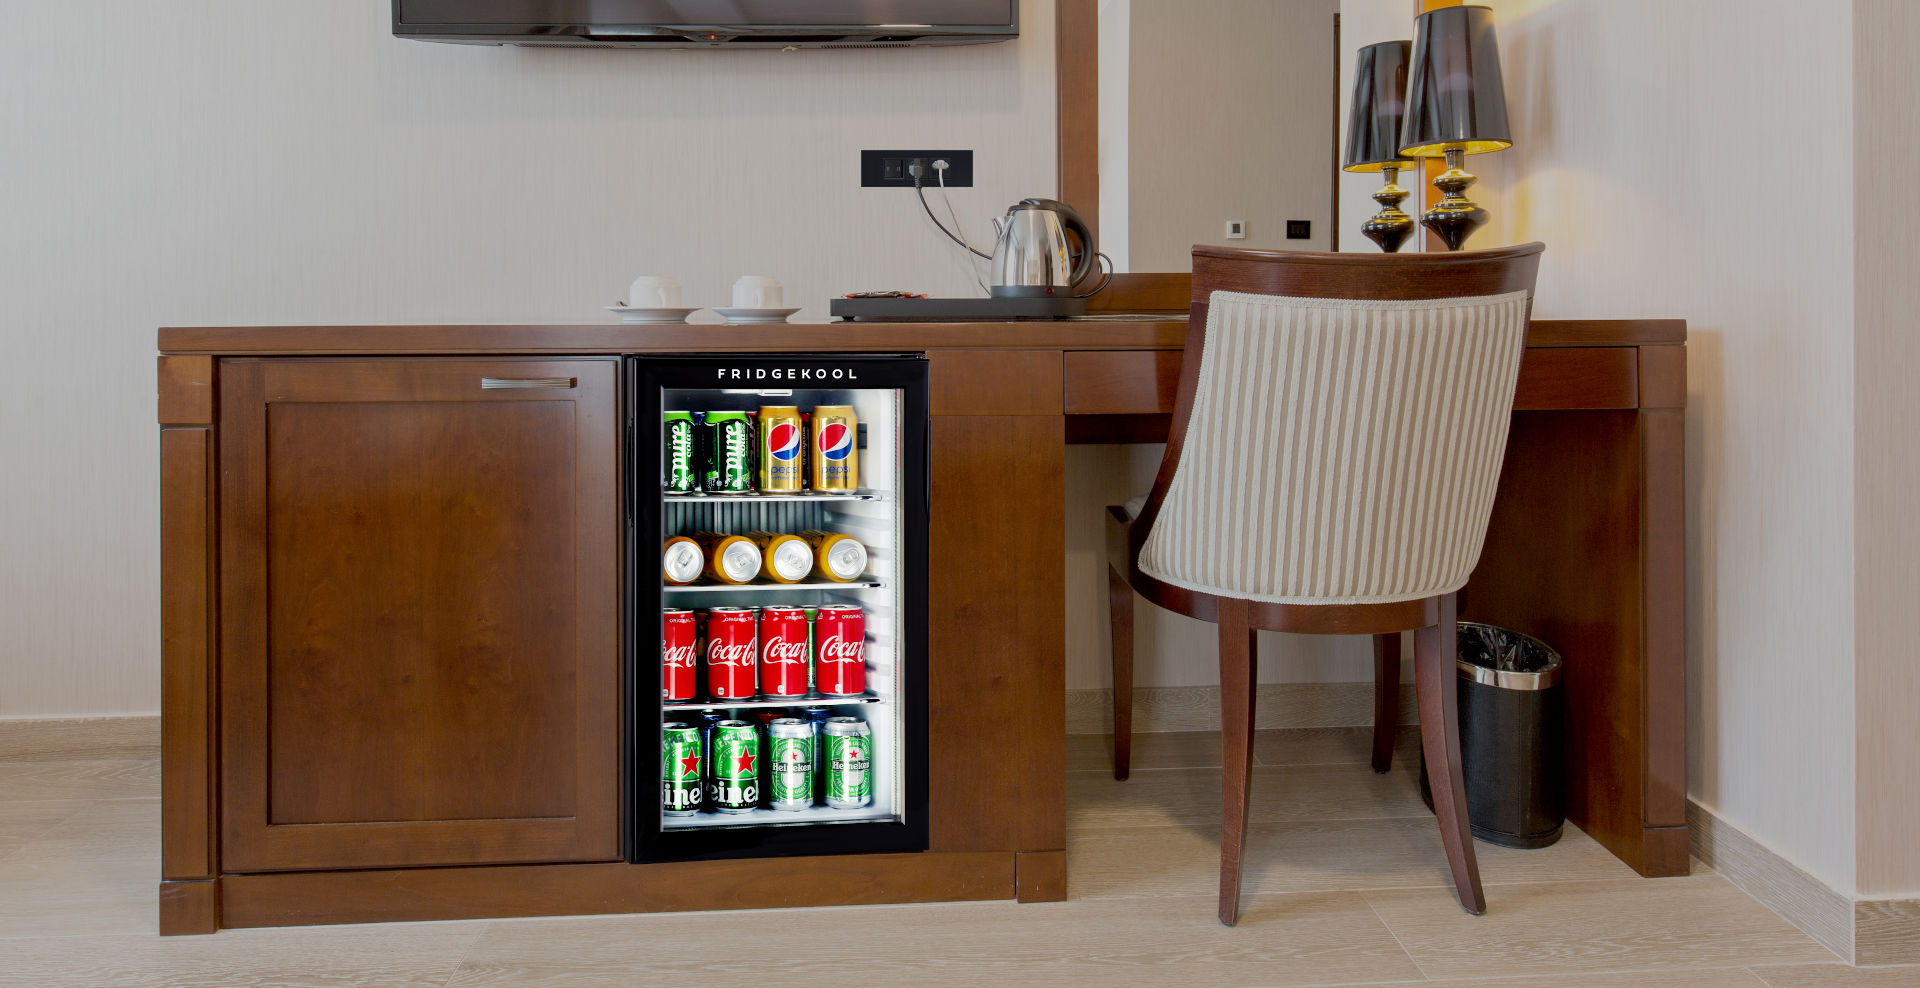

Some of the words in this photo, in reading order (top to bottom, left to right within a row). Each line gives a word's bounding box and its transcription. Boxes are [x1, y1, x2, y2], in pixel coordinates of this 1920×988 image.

[718, 369, 857, 379] FRIDGEKOOL
[671, 421, 688, 474] pure
[725, 421, 742, 474] pure
[737, 434, 746, 458] cola
[771, 465, 800, 476] pepsi
[821, 464, 851, 476] pepsi
[772, 762, 812, 772] Heieken
